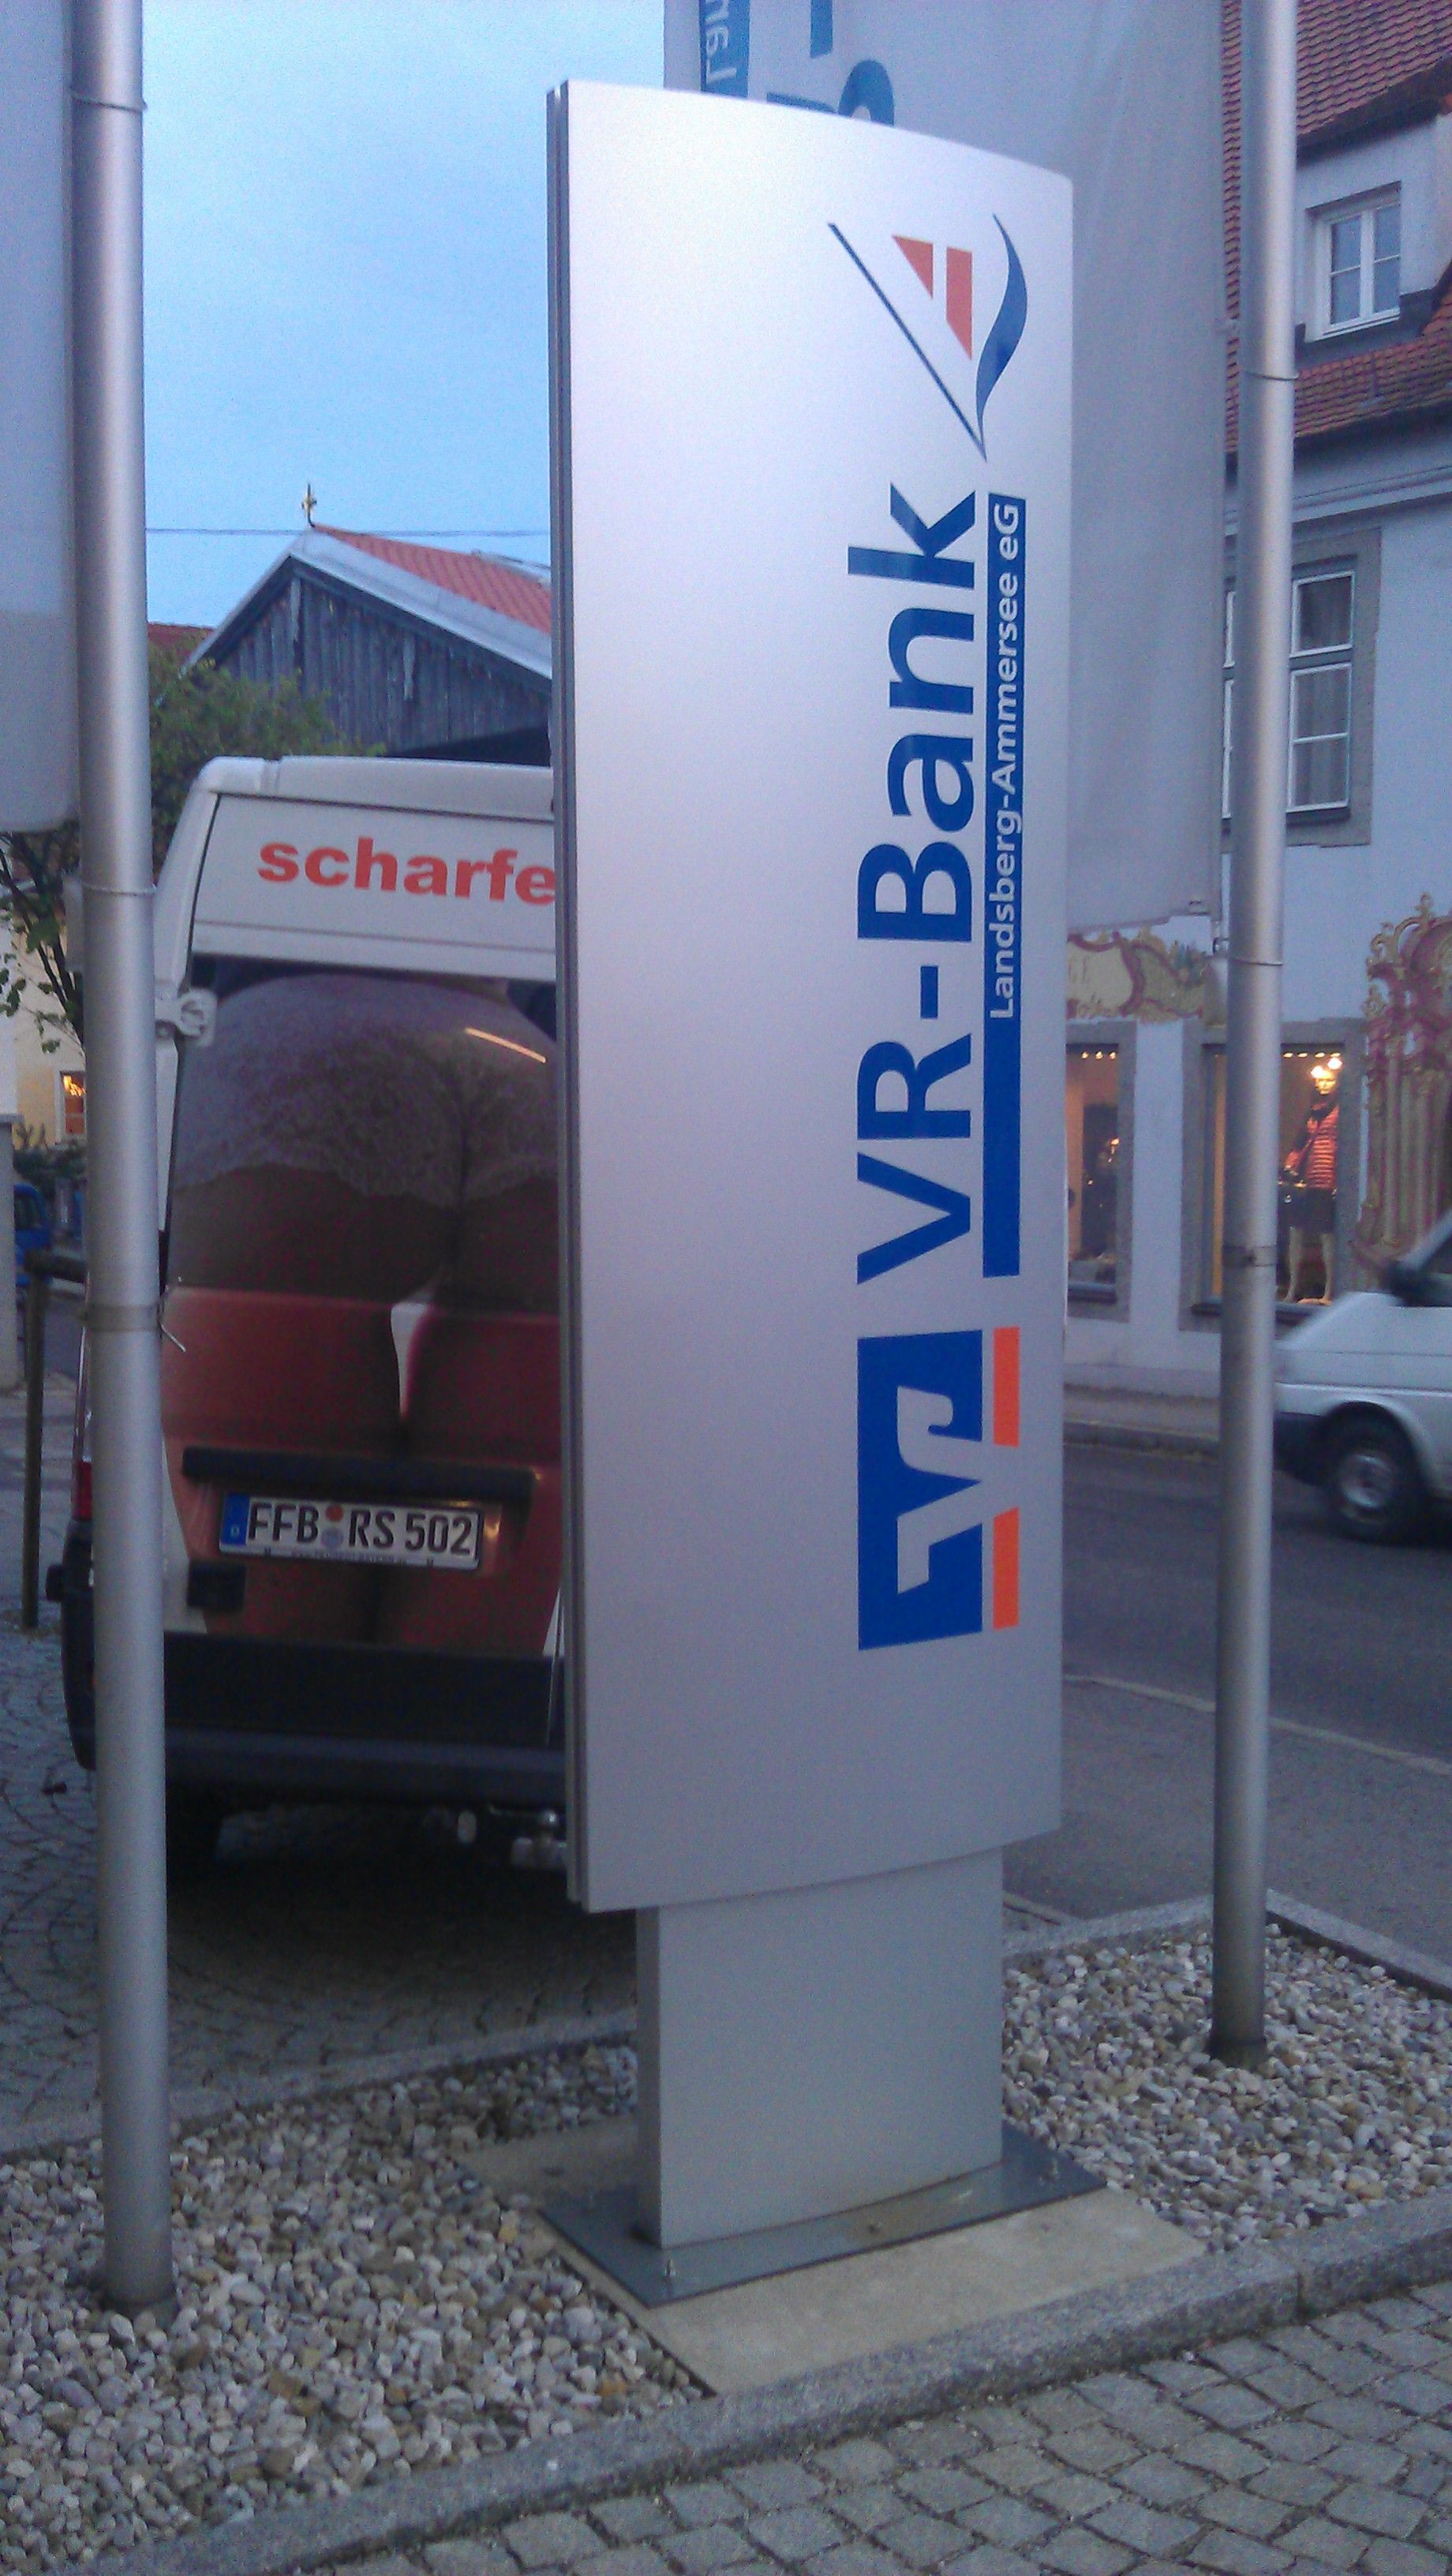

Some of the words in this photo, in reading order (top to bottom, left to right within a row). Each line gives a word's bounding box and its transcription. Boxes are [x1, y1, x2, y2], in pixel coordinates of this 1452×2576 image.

[994, 502, 1020, 561] eG
[990, 571, 1023, 1020] Landsberg-Ammersee
[257, 836, 556, 907] scharfe
[847, 481, 976, 1285] VR-Bank
[248, 1503, 319, 1543] FFB
[348, 1509, 395, 1549] RS
[405, 1512, 472, 1555] 502
